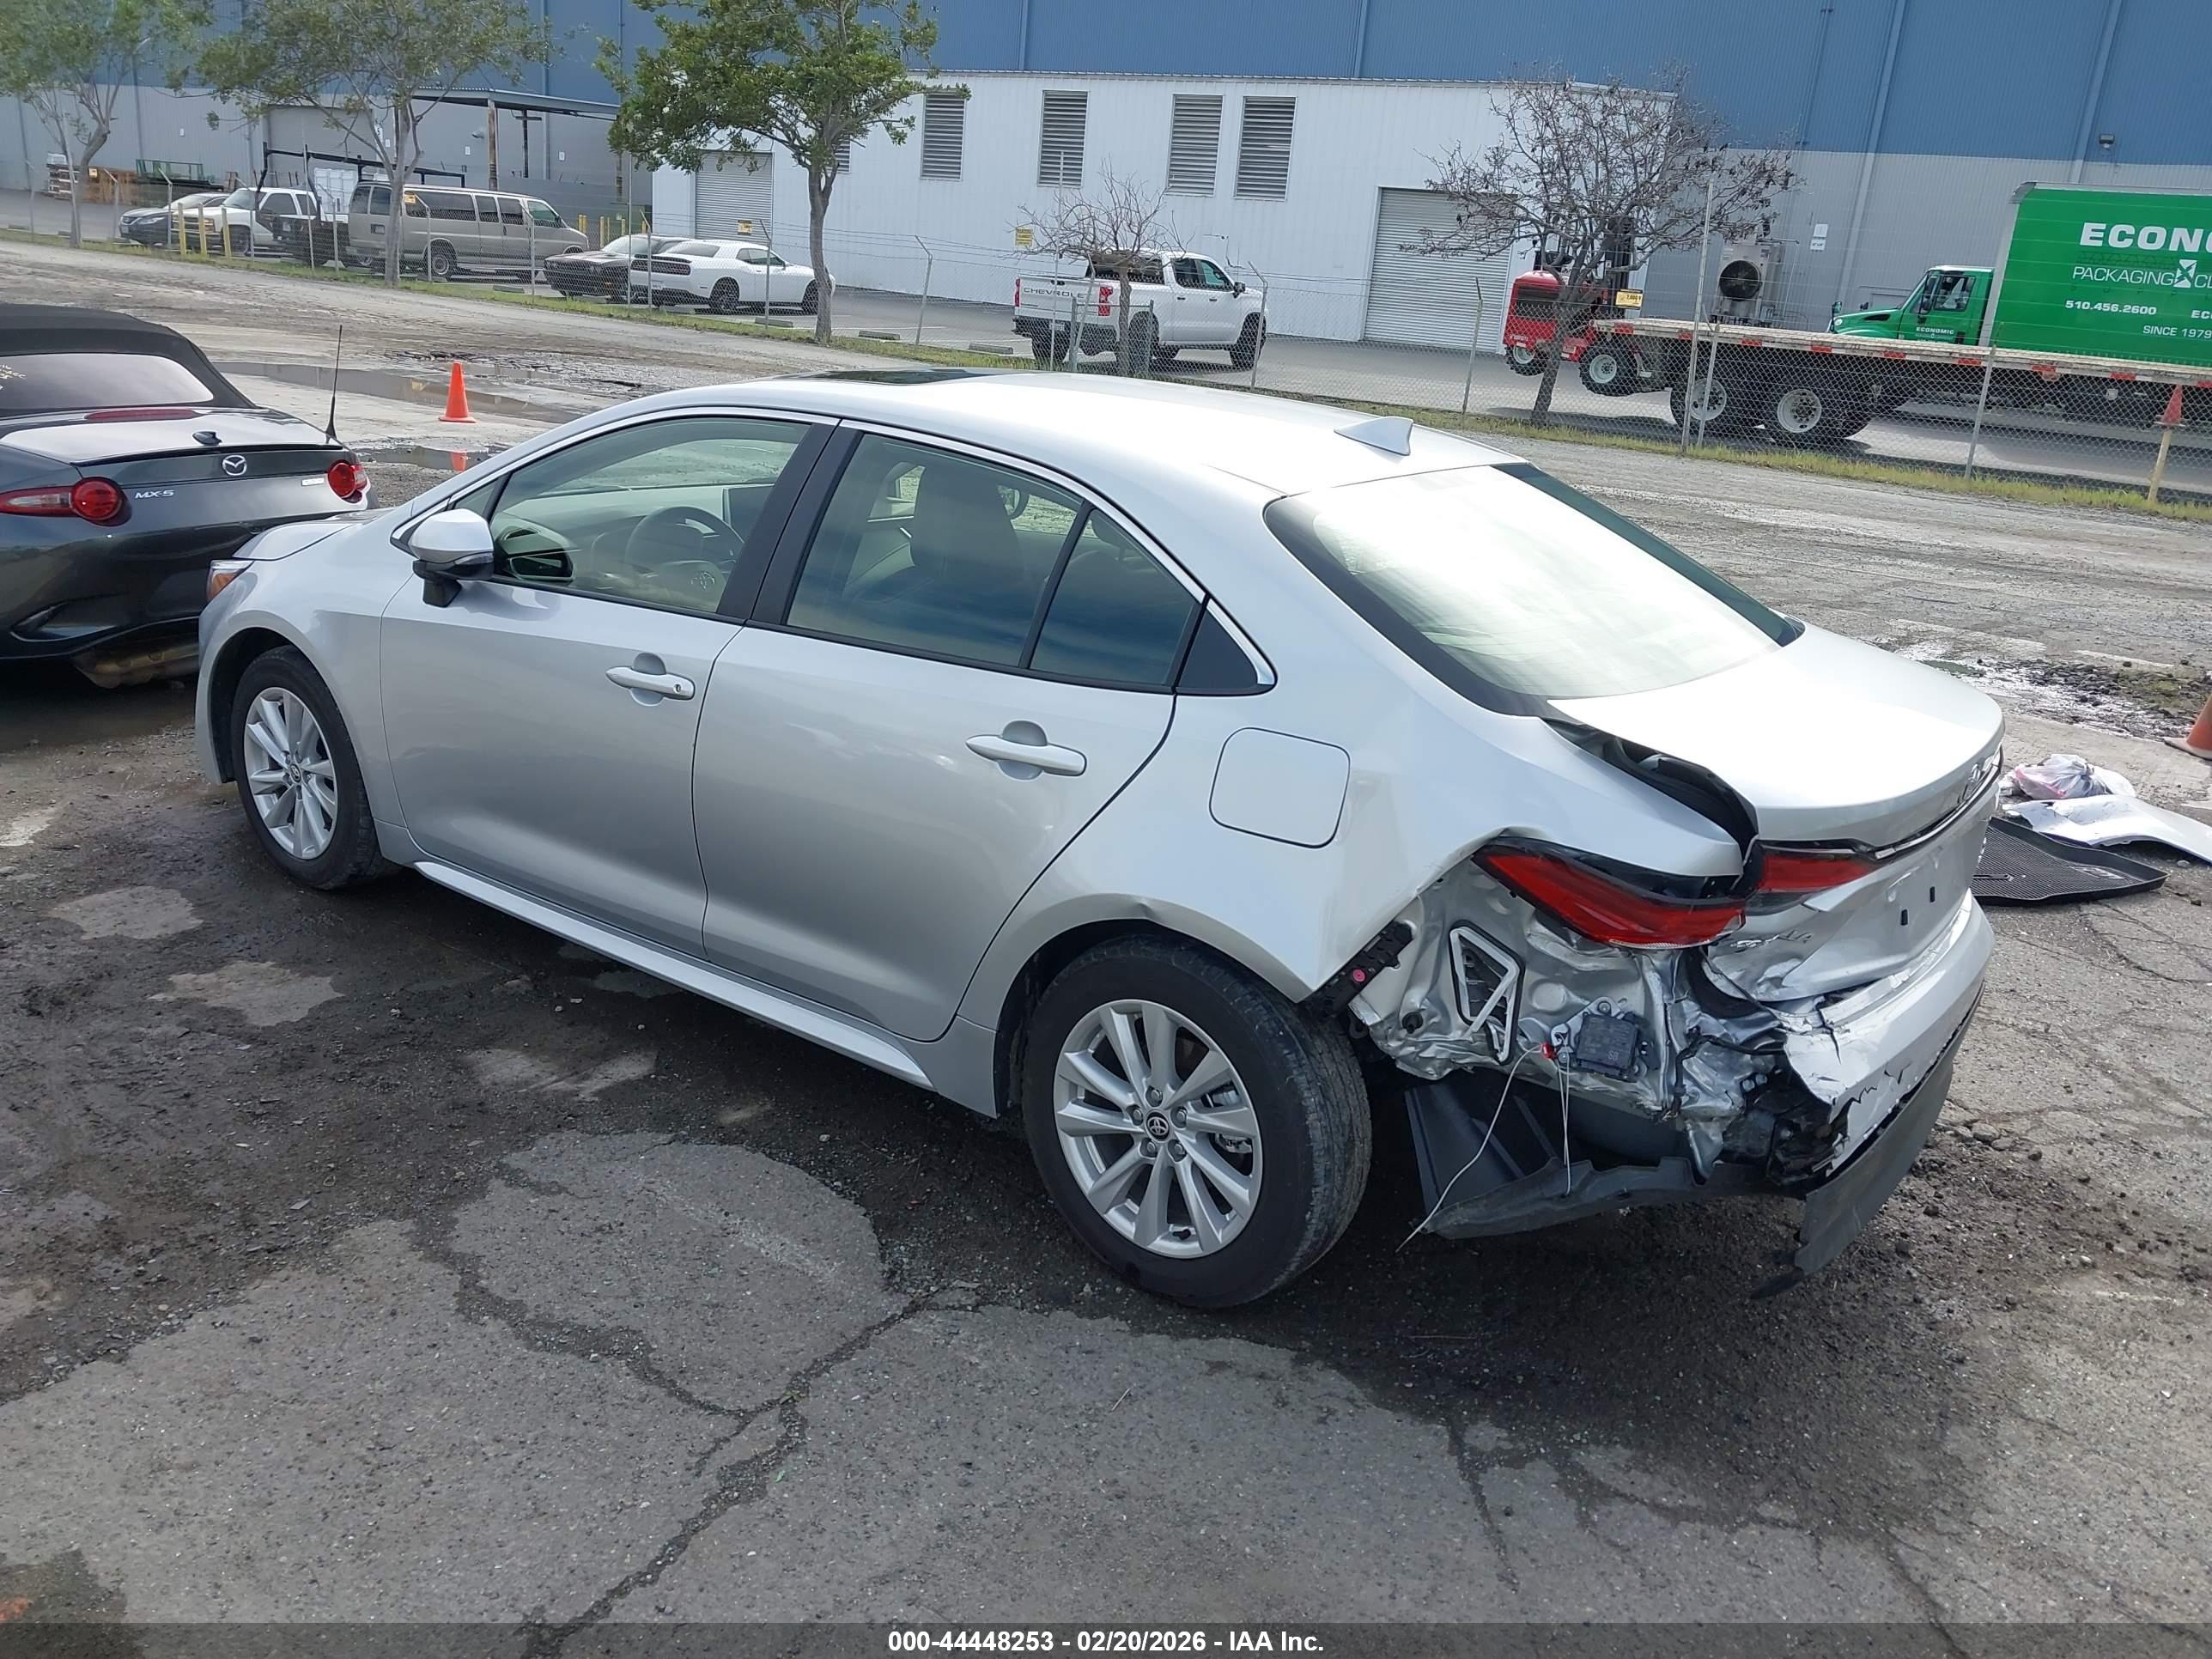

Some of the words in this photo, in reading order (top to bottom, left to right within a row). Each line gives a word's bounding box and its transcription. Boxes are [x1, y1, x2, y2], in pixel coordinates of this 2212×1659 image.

[2080, 222, 2212, 252] ECON
[2072, 266, 2175, 286] PACKAGING
[2065, 301, 2157, 315] 510.456.2600
[1916, 326, 1954, 335] ECONOMIC
[2143, 325, 2178, 336] SINCE
[2182, 328, 2212, 338] 1979
[136, 489, 174, 499] MX-5
